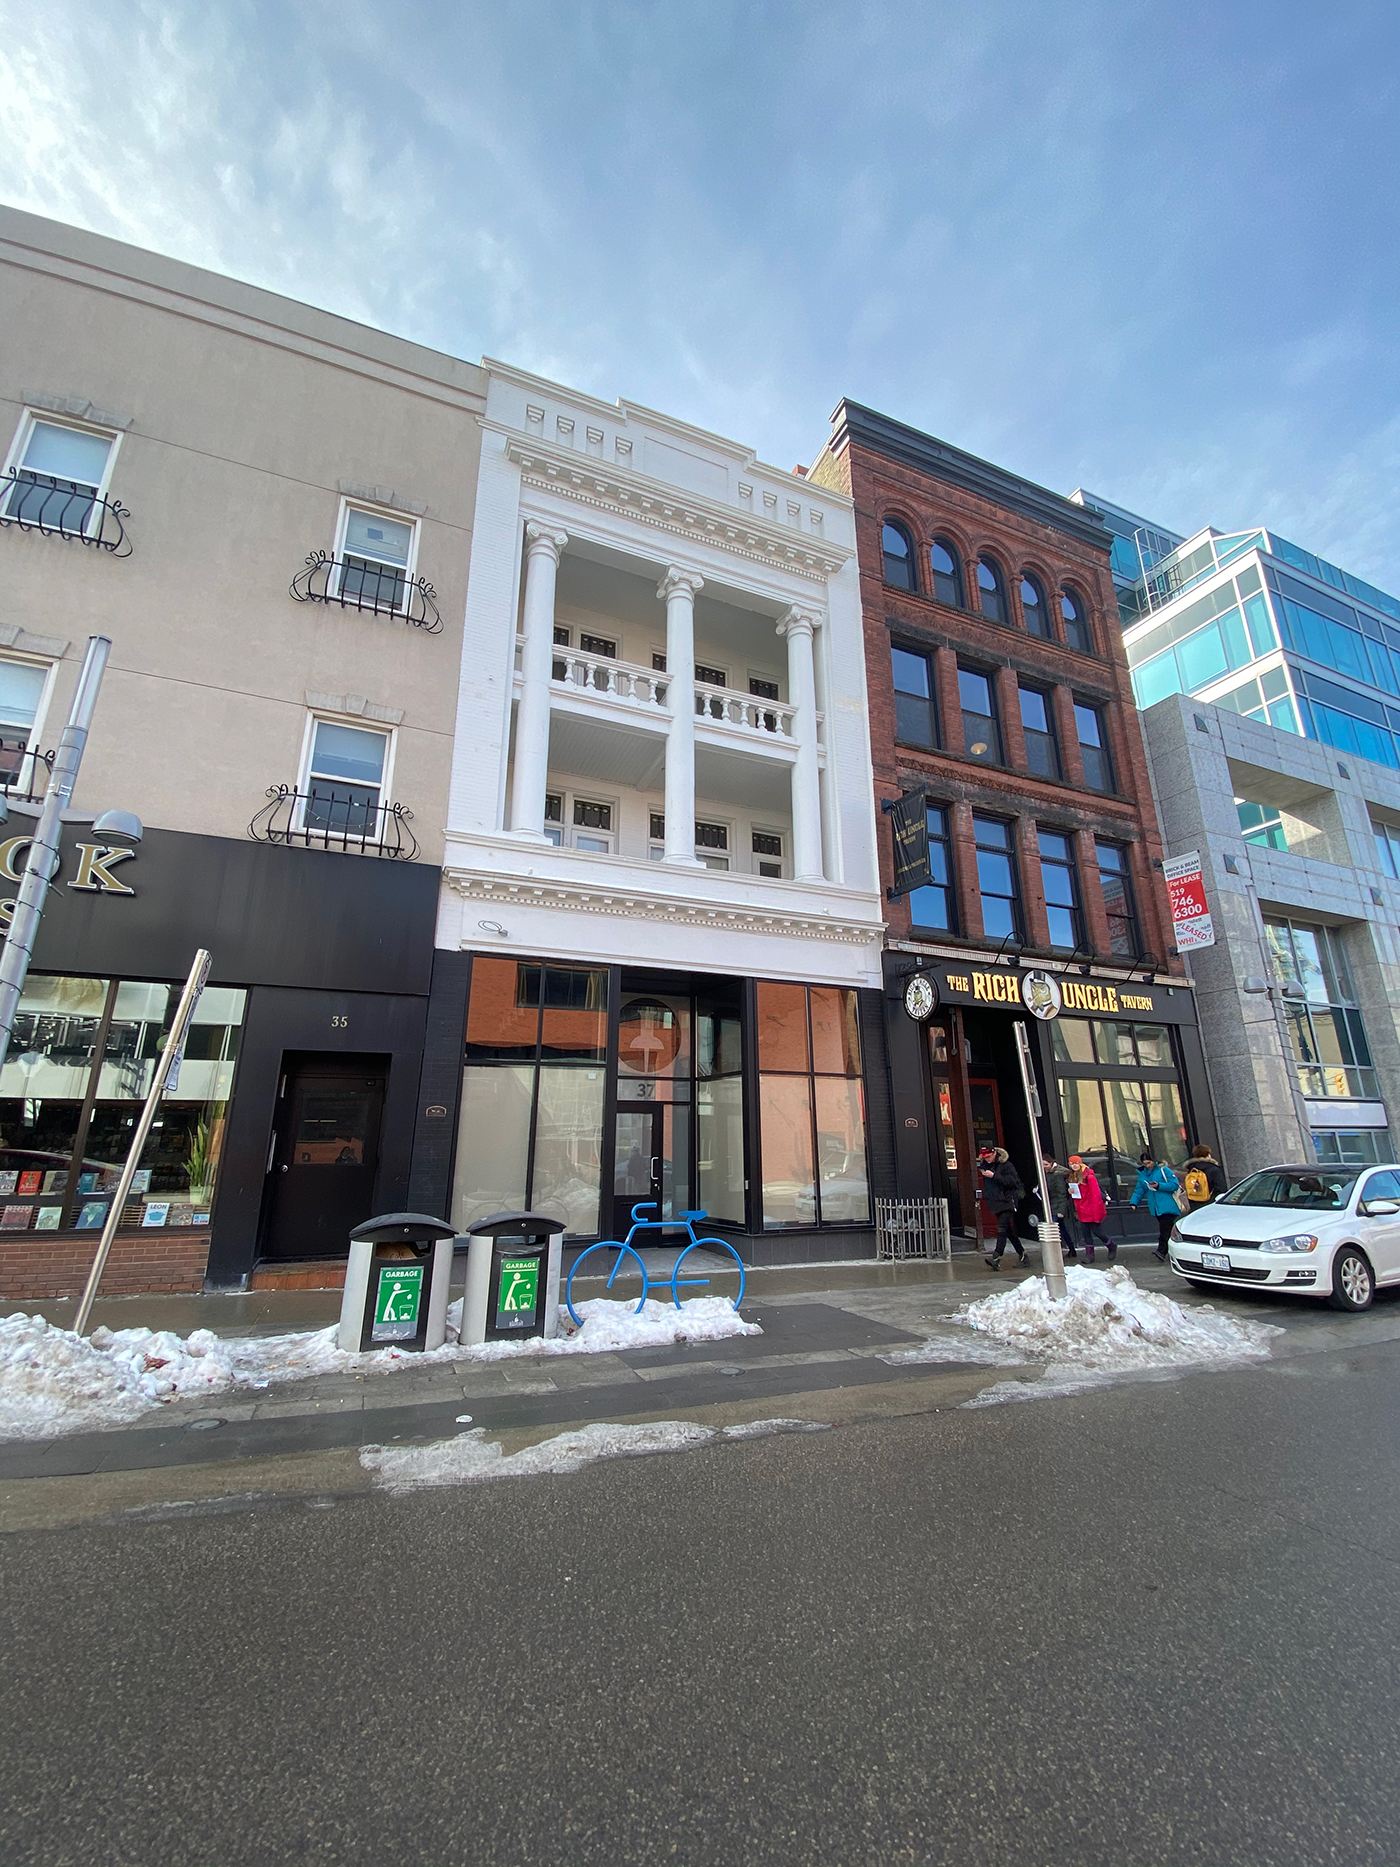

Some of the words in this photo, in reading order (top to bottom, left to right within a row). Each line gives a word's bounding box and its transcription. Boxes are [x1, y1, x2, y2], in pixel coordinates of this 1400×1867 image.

[1165, 865, 1180, 874] BRICK
[1184, 859, 1199, 868] BEAM
[1184, 865, 1200, 874] SPACE
[1169, 880, 1179, 888] For
[1180, 874, 1200, 884] LEASE
[1170, 887, 1185, 898] 519
[1172, 895, 1194, 909] 746
[1173, 903, 1203, 919] 6300
[1181, 922, 1207, 941] LEASED
[946, 974, 969, 992] THE
[972, 972, 1021, 1003] RICH
[1060, 982, 1119, 1012] UNCLE
[1120, 994, 1153, 1011] TAVERN
[331, 1016, 348, 1028] 35
[636, 1083, 655, 1097] 37
[385, 1270, 419, 1278] GARBAGE
